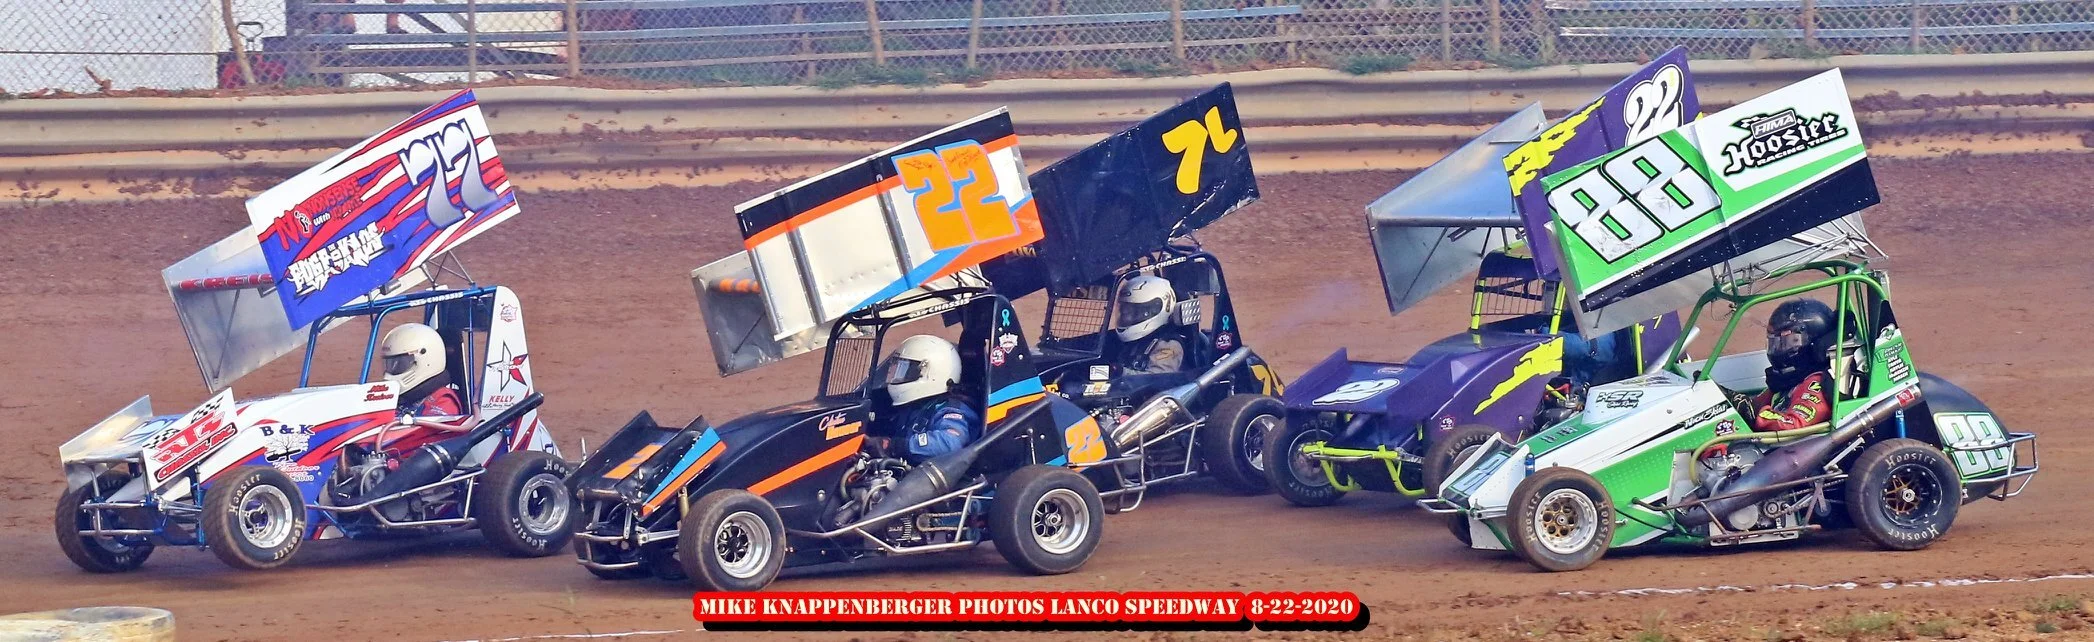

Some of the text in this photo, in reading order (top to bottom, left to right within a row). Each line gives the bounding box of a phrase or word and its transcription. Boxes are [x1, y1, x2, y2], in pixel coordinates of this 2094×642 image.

[1623, 64, 1684, 146] 22
[397, 118, 501, 229] 77
[1721, 112, 1840, 176] Hoosier
[1756, 129, 1847, 167] RACING TIRES
[891, 139, 1021, 254] 22
[1546, 136, 1722, 264] 88
[929, 297, 971, 313] CHASSIS
[259, 424, 314, 437] B & K
[489, 395, 515, 403] KELLY
[1064, 415, 1108, 466] 22
[1933, 412, 2013, 479] 88
